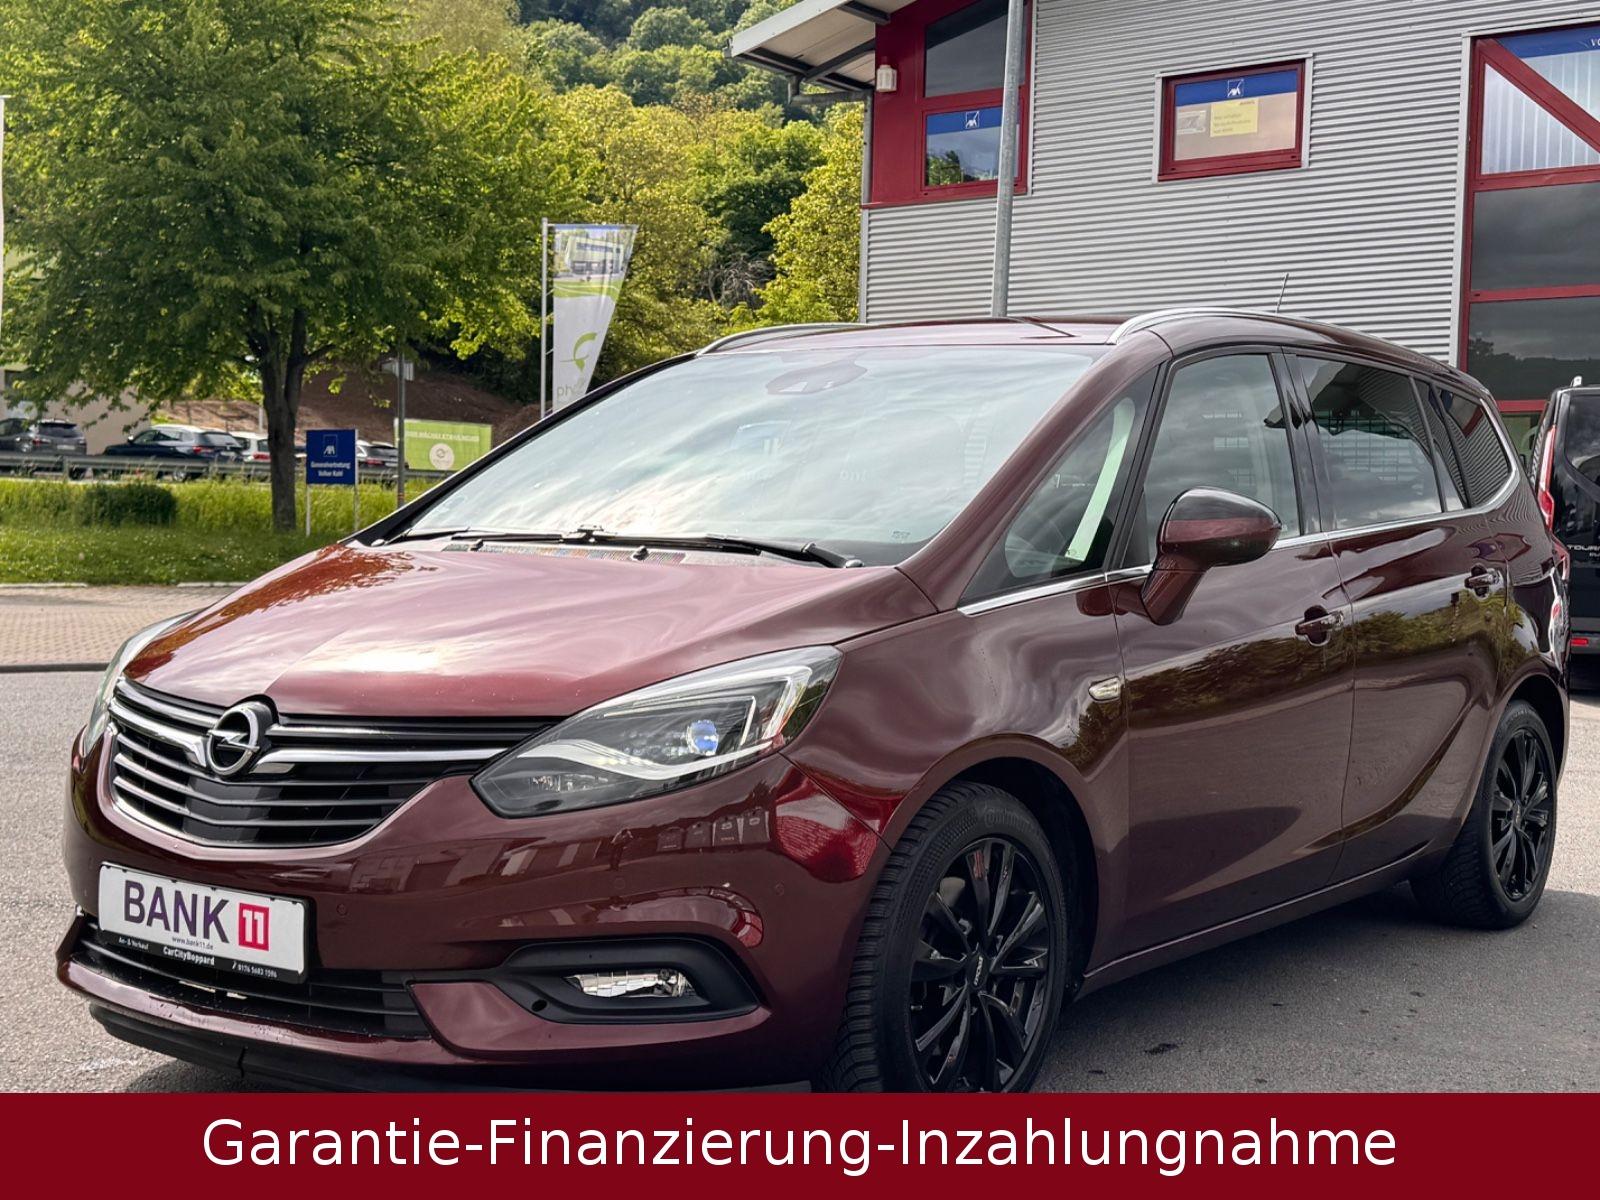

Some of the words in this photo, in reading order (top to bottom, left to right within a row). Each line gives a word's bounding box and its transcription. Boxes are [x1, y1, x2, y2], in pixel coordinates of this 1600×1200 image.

[124, 879, 230, 944] BANK
[241, 908, 265, 946] 11
[171, 935, 214, 951] www.bank11.de
[163, 946, 215, 966] CarCityBoppard
